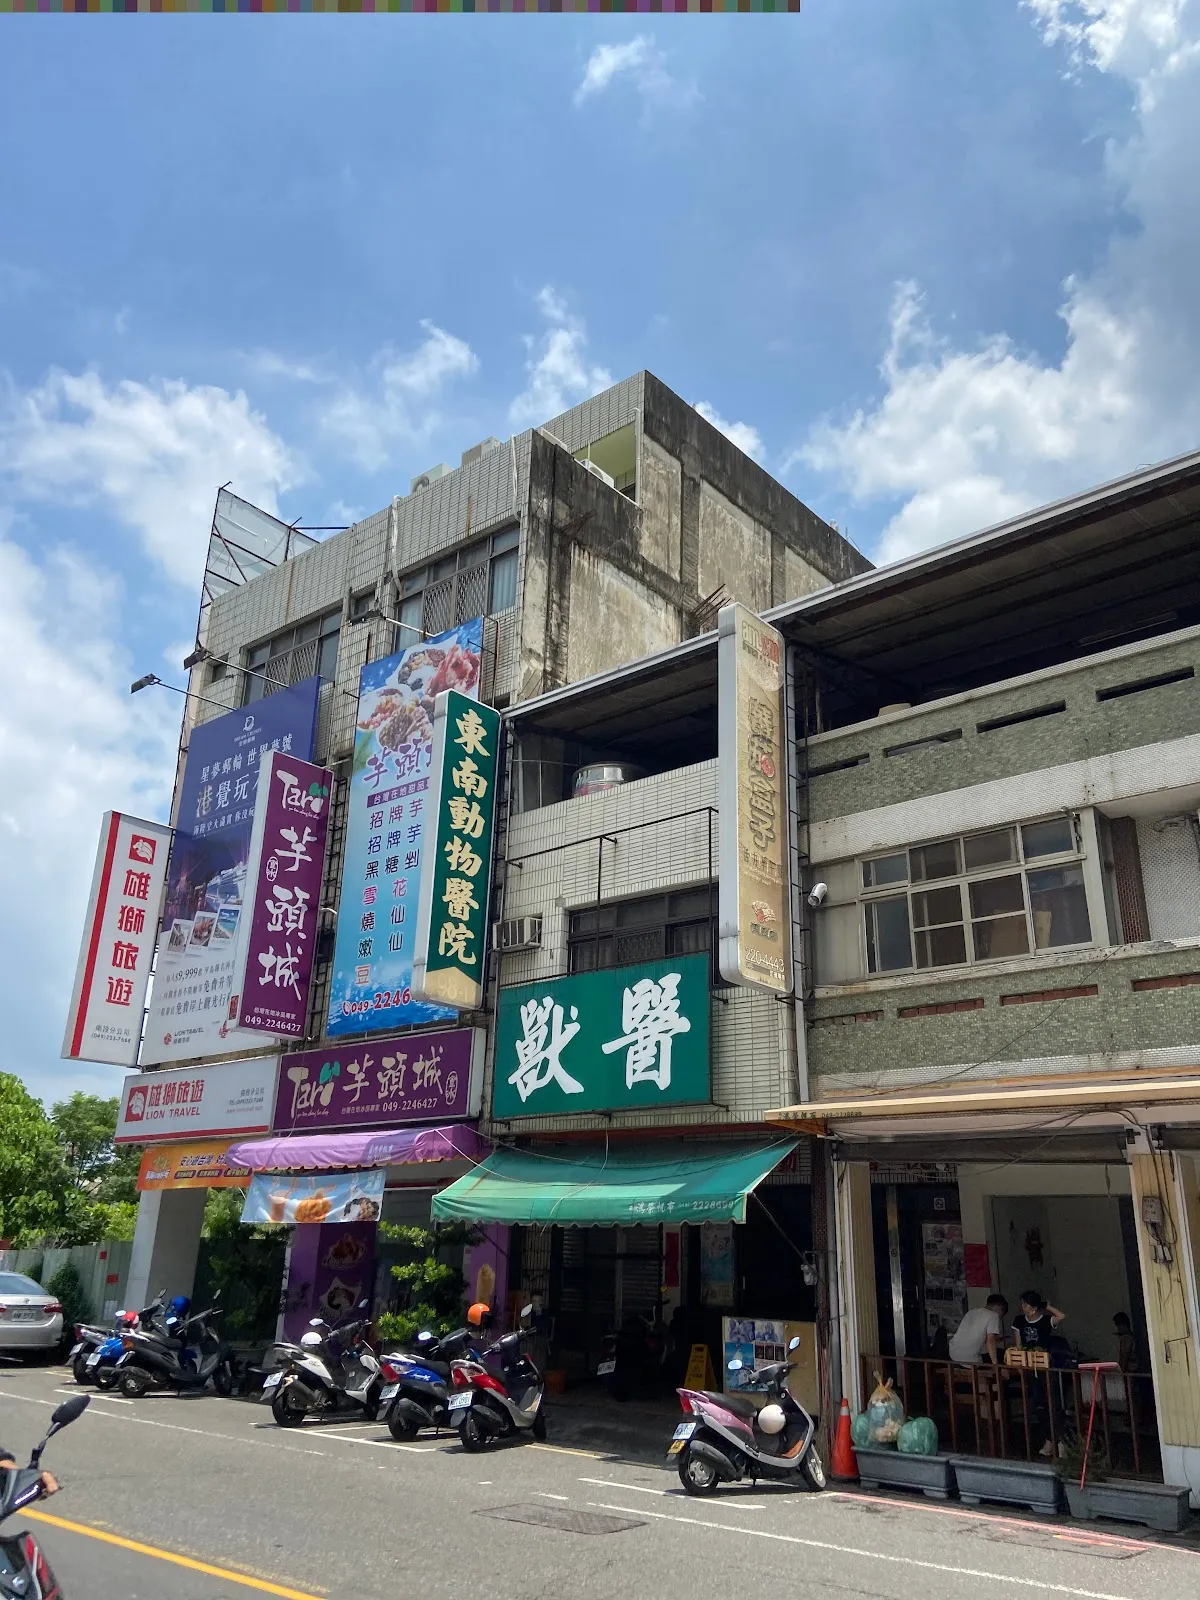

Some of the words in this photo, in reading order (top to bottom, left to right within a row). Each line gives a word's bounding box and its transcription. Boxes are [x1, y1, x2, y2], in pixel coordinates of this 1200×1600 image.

[200, 753, 242, 784] 星夢郵輪
[276, 769, 324, 813] Taro
[373, 779, 430, 806] 台灣在地甜品
[369, 798, 424, 831] 招牌芋
[367, 823, 422, 855] 招牌芋
[438, 708, 491, 966] 東南動物醫院
[364, 848, 420, 881] 黑糖剉
[363, 878, 408, 905] 雪花
[257, 826, 318, 1001] 芋頭城
[360, 904, 406, 932] 燒仙
[105, 868, 152, 1007] 雄獅旅遊
[357, 931, 404, 959] 嫩仙
[355, 964, 371, 985] 豆
[351, 987, 412, 1013] 049-2246
[507, 972, 691, 1103] 獸醫
[342, 1045, 444, 1104] 芋頭城
[148, 1079, 205, 1107] 雄獅旅遊
[287, 1066, 335, 1119] Taro
[382, 1098, 438, 1113] 049-2246427
[146, 1110, 165, 1120] LION
[169, 1107, 200, 1118] TRAVEL
